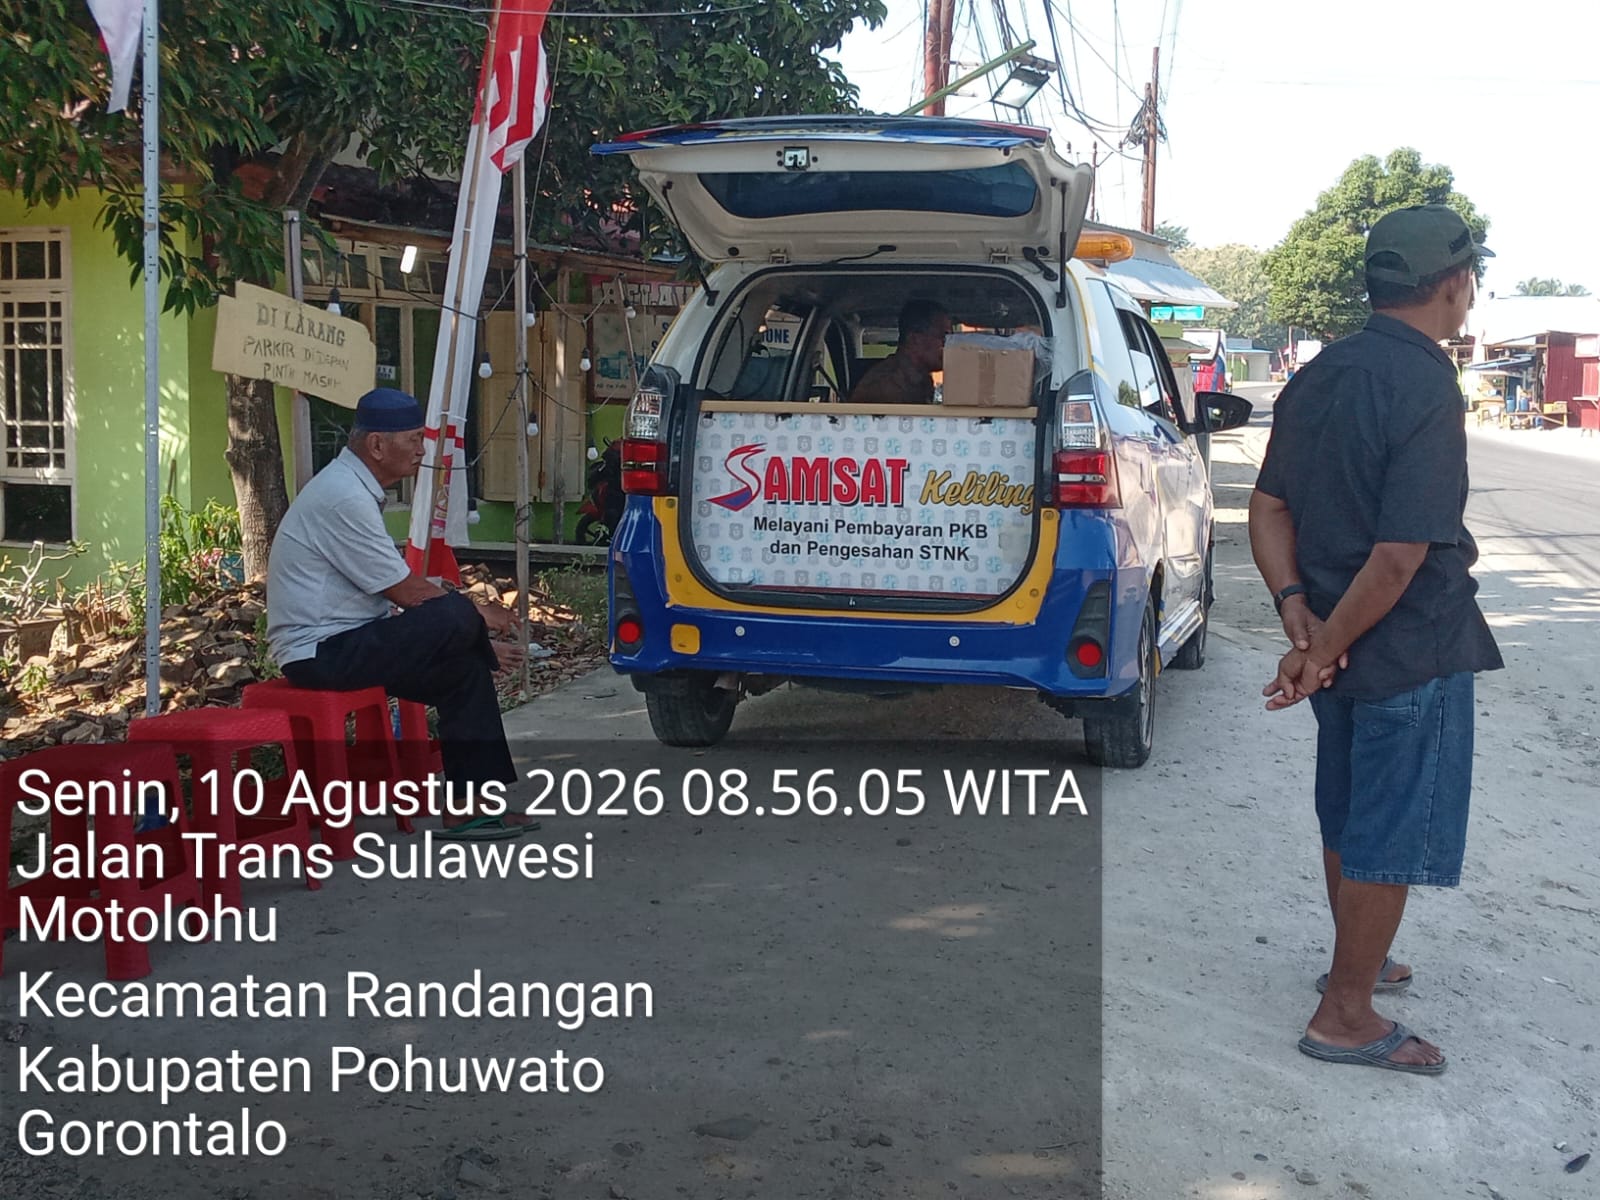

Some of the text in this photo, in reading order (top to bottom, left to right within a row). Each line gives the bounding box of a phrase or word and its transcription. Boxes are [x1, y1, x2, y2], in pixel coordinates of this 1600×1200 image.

[284, 308, 346, 347] LARANG
[242, 335, 295, 358] PARKIR
[706, 442, 1035, 516] SAMSAT Keliling
[753, 516, 988, 539] Melayani Pembayaran PKB
[769, 539, 970, 562] dan Pengesahan STNK
